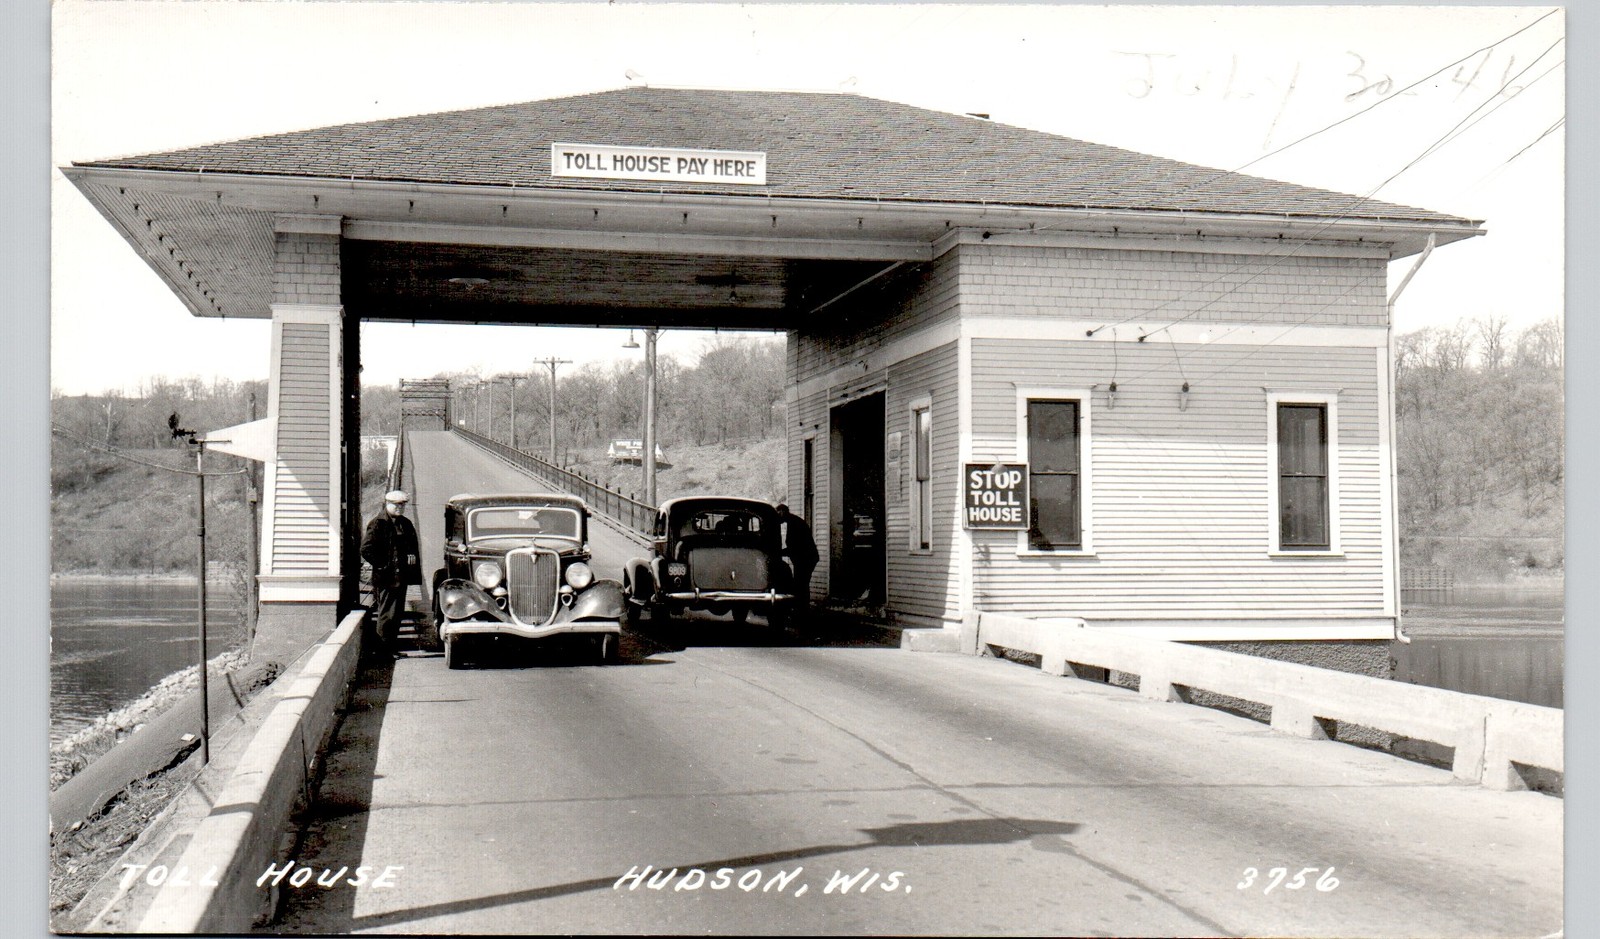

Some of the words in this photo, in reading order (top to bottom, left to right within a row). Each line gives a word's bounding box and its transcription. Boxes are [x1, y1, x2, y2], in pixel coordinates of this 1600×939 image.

[563, 152, 607, 171] TOLL
[613, 155, 670, 173] HOUSE
[677, 157, 708, 175] PAY
[713, 159, 756, 177] HERE
[970, 470, 1022, 490] STOP
[970, 490, 1020, 506] TOLL
[969, 506, 1022, 522] HOUSE
